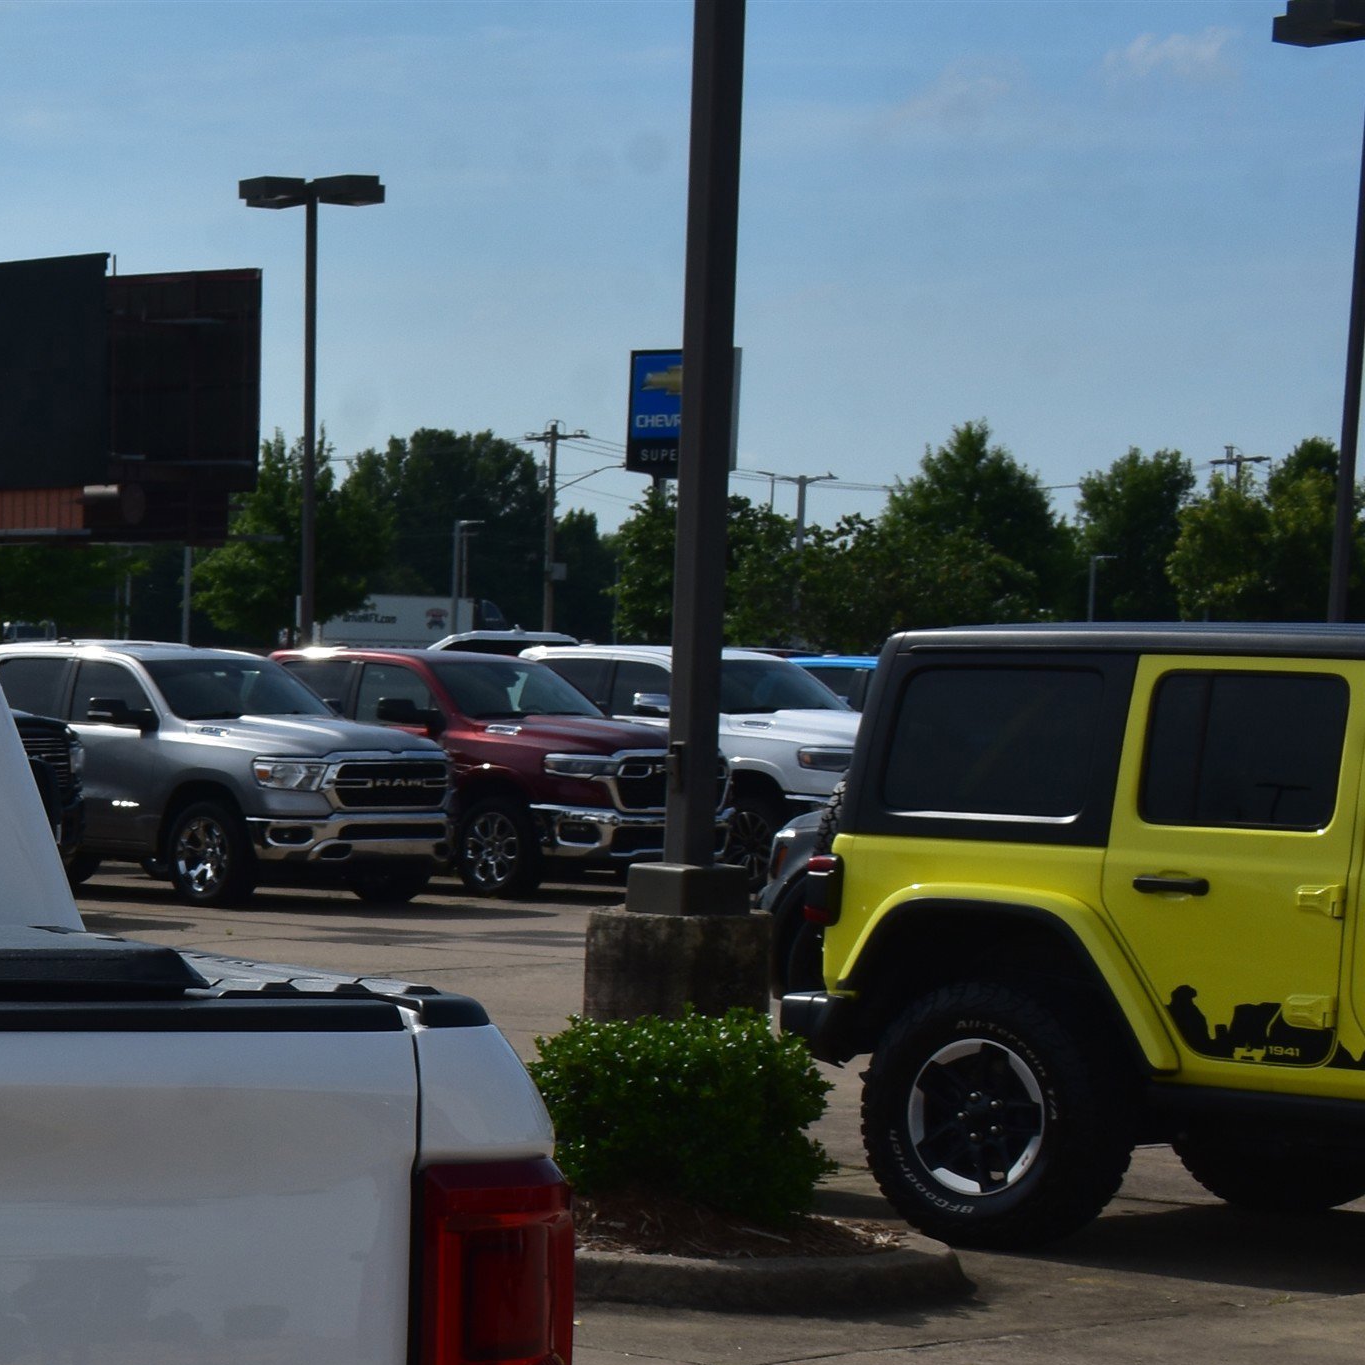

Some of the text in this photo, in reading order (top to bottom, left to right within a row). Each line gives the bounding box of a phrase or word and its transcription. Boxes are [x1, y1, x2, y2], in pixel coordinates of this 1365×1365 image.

[375, 777, 422, 788] RAM
[1268, 1045, 1300, 1057] 1941
[888, 1128, 976, 1215] BFGoodrich
